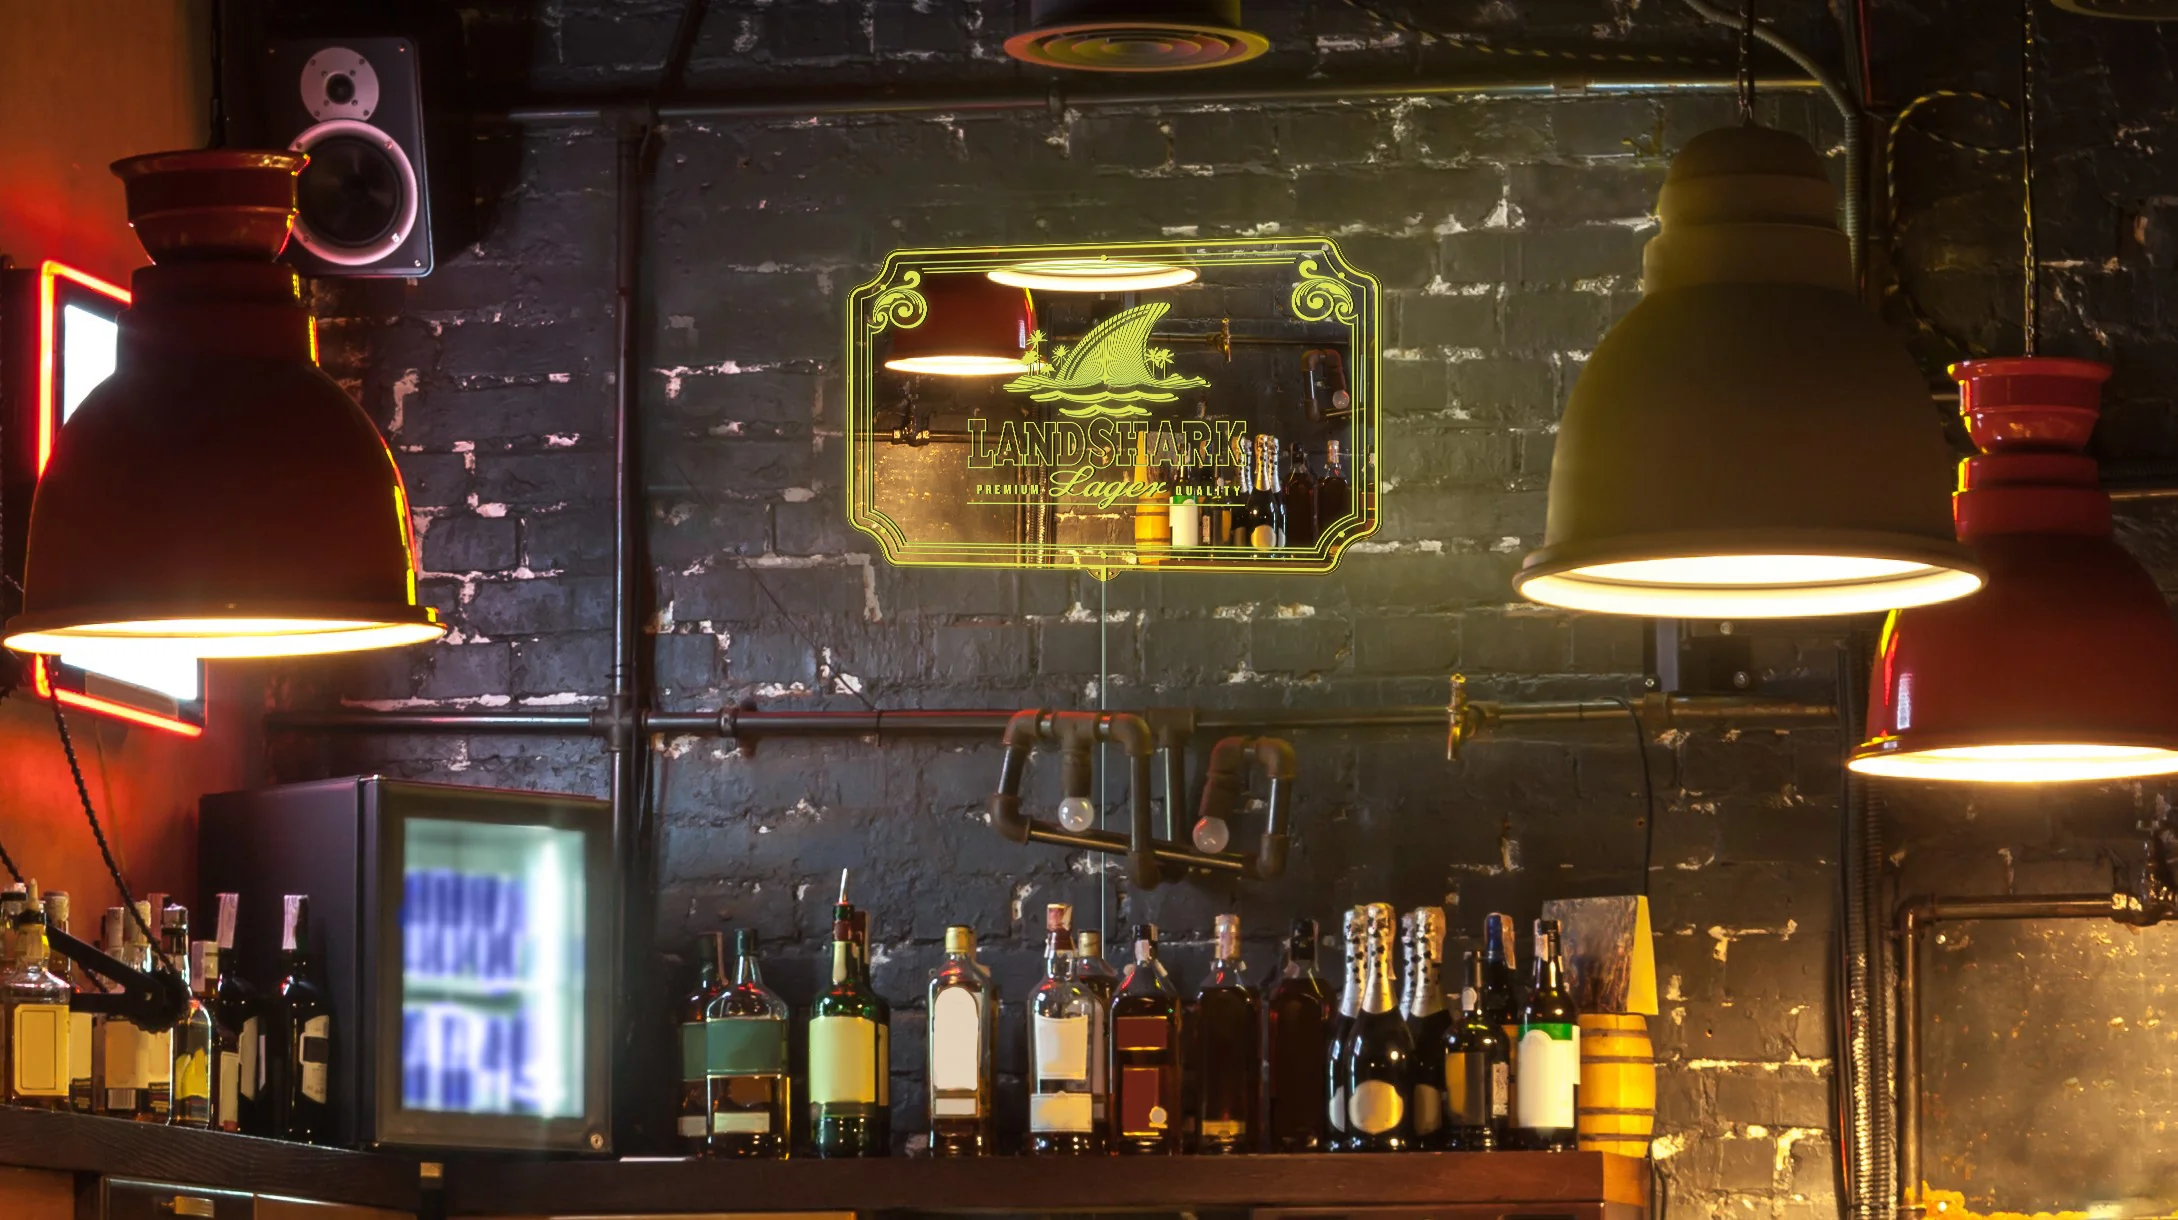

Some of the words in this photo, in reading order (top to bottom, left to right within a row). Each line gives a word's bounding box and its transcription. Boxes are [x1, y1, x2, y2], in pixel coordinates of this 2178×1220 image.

[968, 417, 1247, 469] LANDSHARK
[976, 484, 1039, 495] PREMIUM
[1048, 465, 1168, 510] Lager
[1175, 485, 1241, 497] QUALITY
